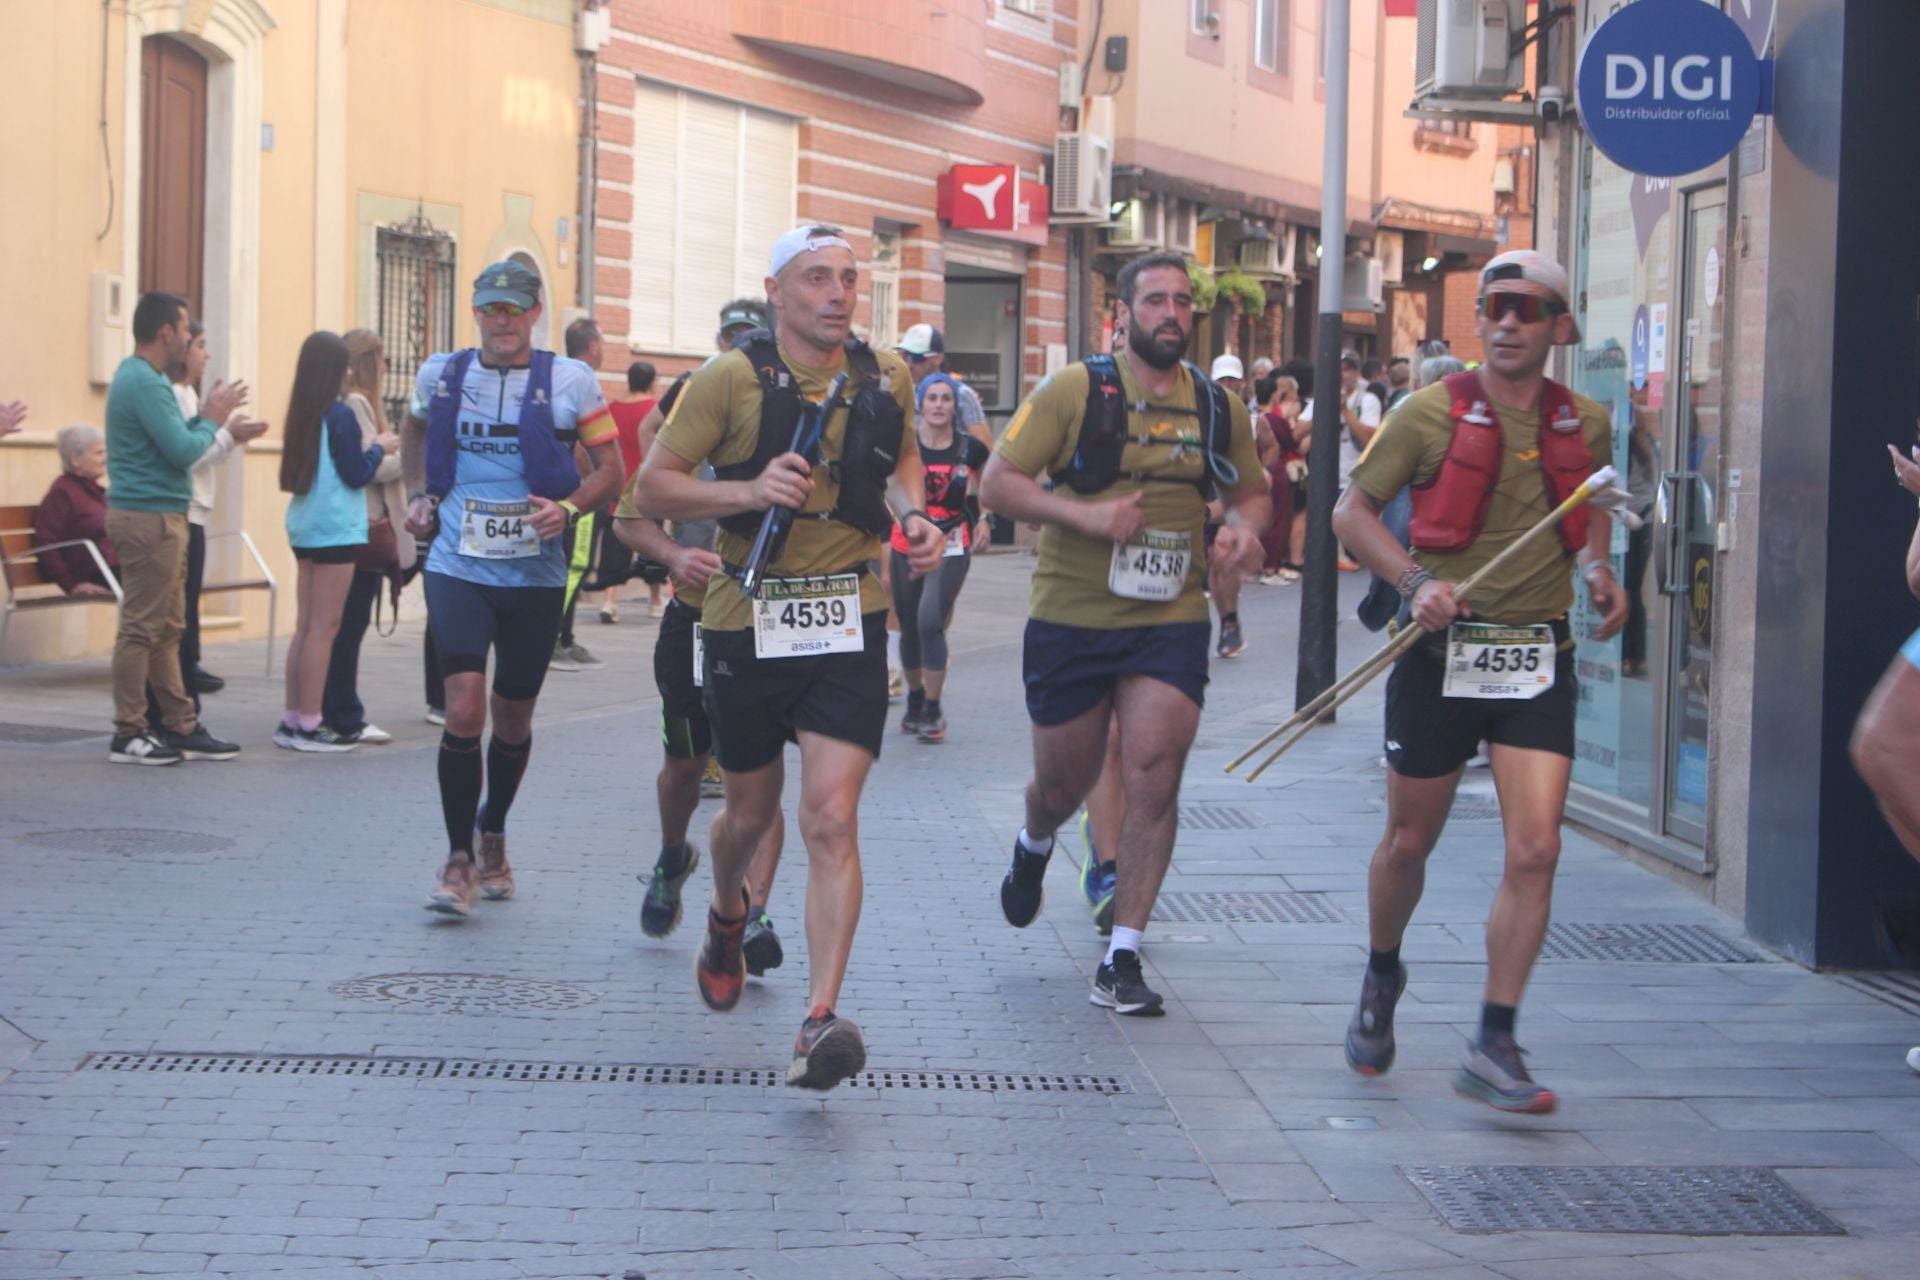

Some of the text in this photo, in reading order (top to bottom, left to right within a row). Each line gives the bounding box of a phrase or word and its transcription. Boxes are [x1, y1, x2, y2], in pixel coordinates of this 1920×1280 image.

[1605, 54, 1732, 101] DIGI
[1605, 106, 1730, 121] Distribuidor oficial
[485, 518, 523, 538] 644
[1133, 550, 1185, 577] 4538
[780, 599, 846, 629] 4539
[1473, 647, 1541, 673] 4535
